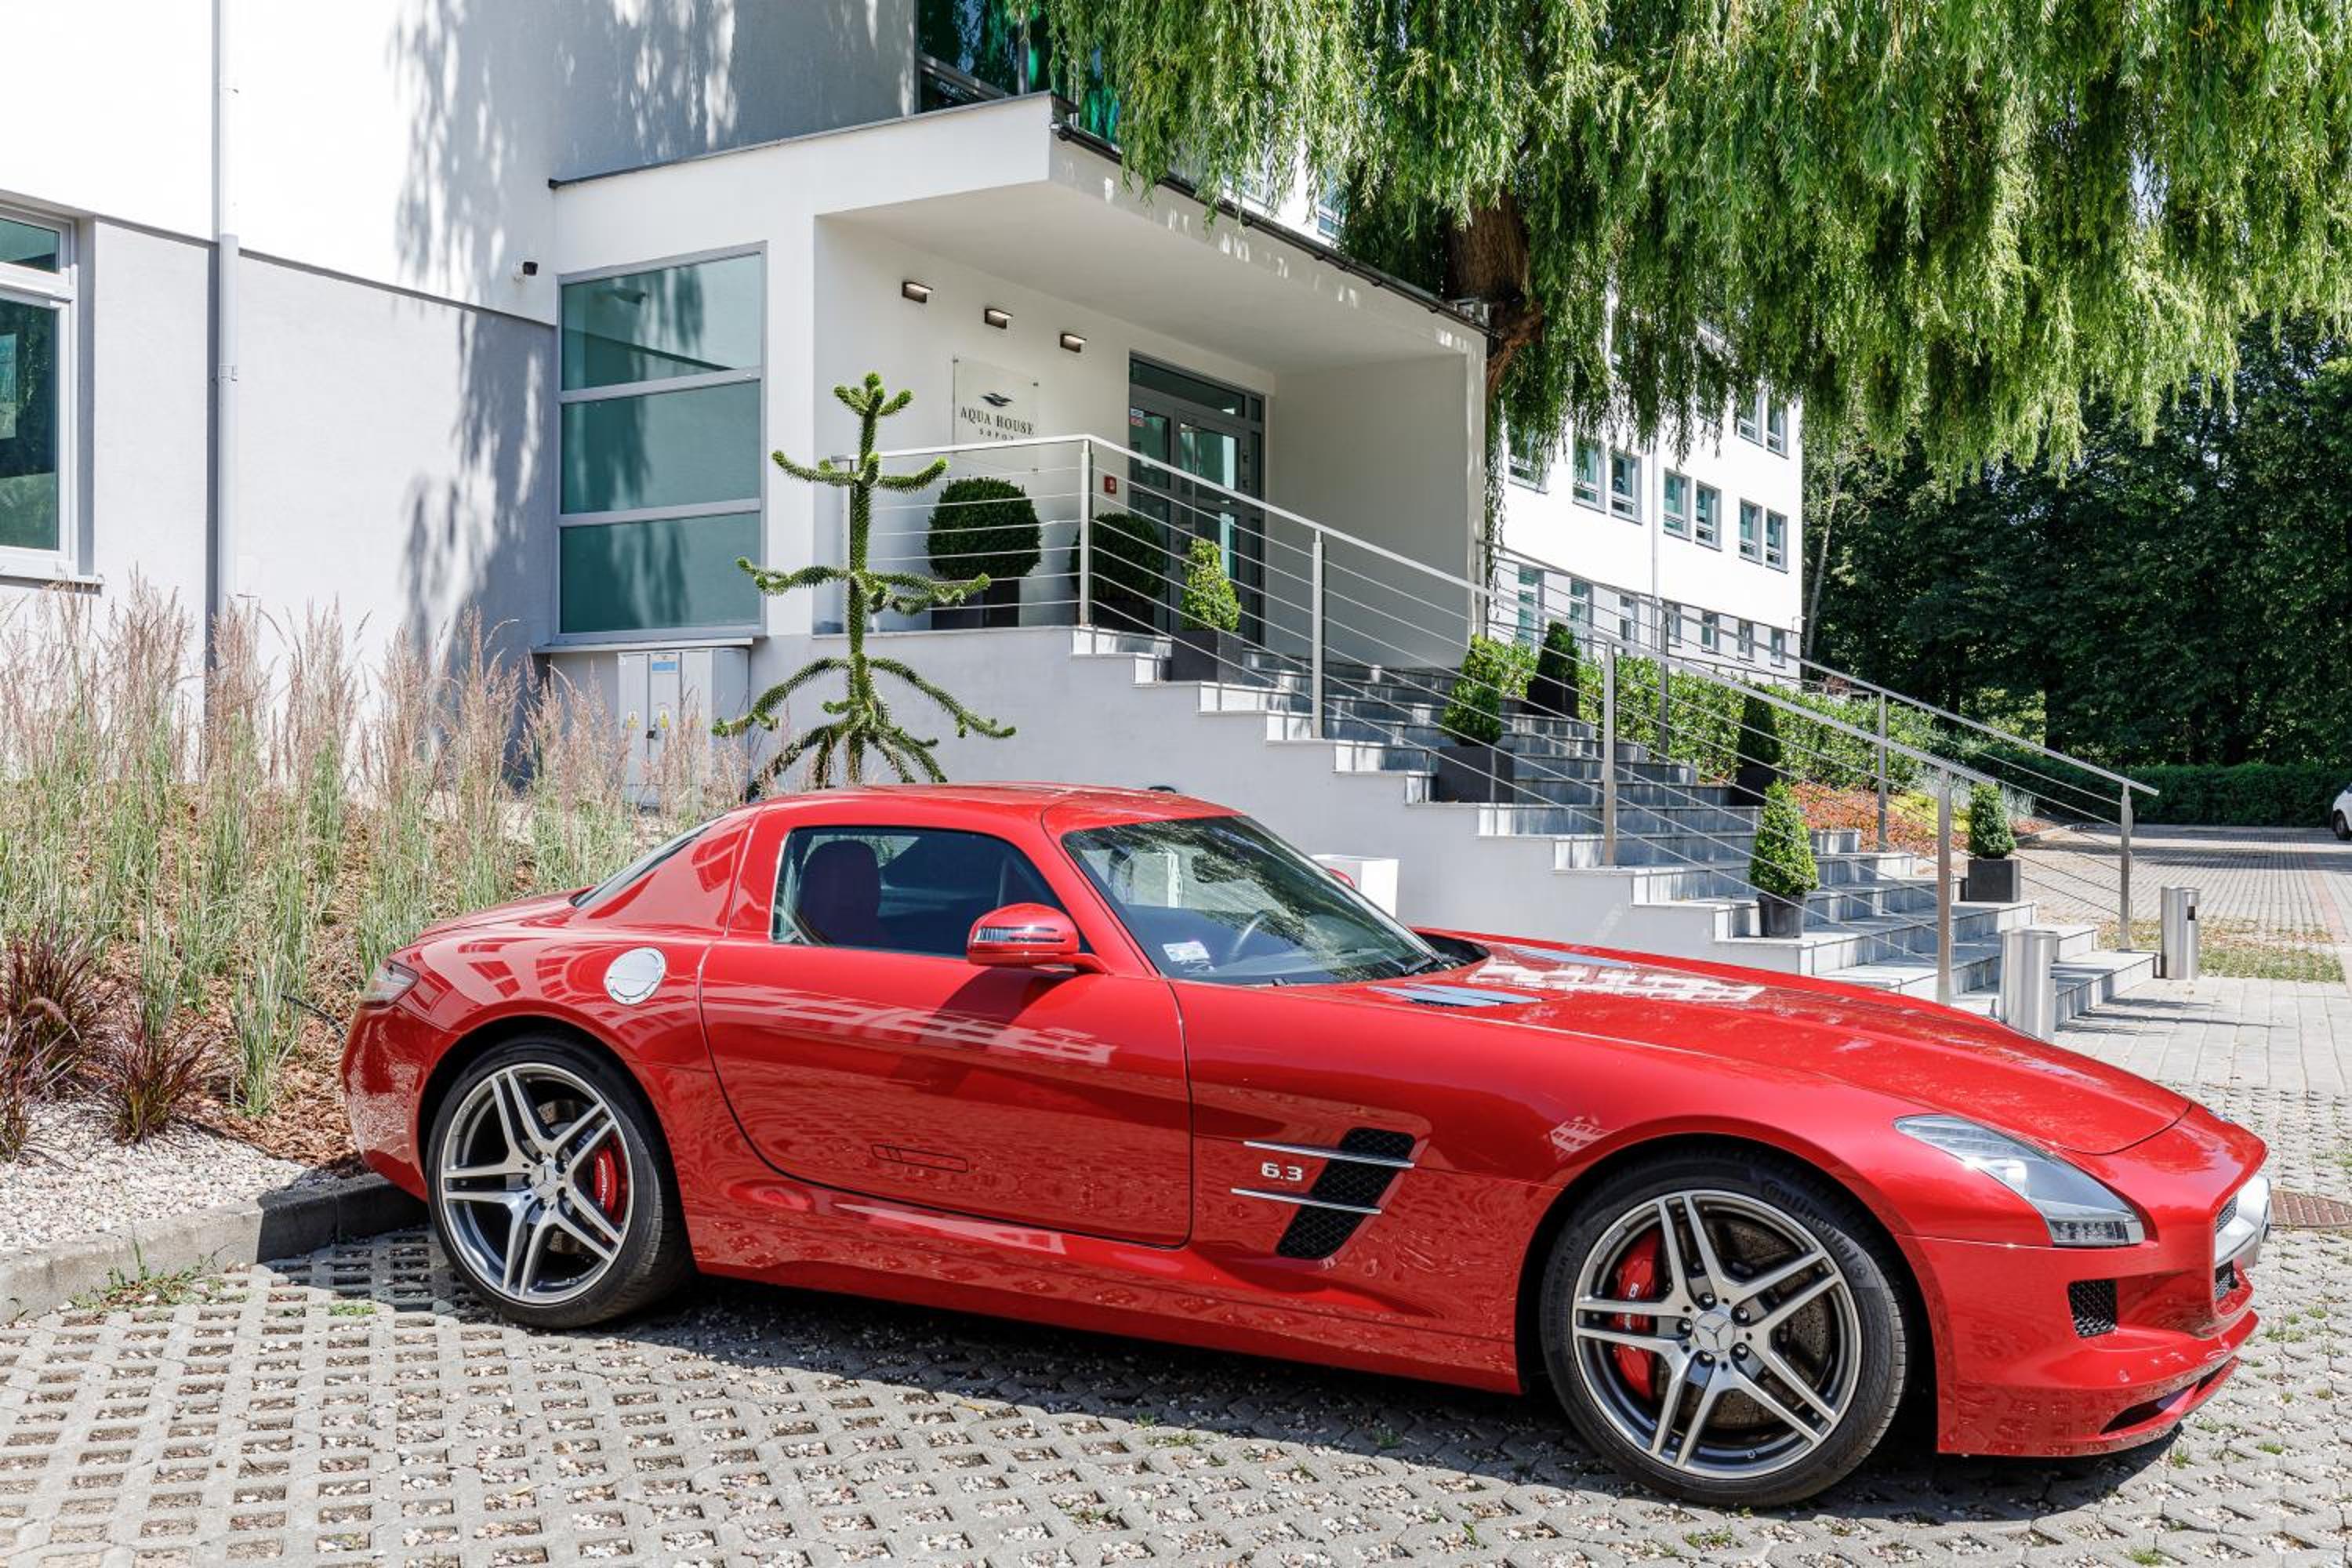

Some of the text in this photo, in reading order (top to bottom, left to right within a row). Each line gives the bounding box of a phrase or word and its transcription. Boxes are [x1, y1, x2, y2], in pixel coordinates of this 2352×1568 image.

[960, 406, 1034, 435] AQUA HOUSE
[1261, 1162, 1303, 1181] 6.3
